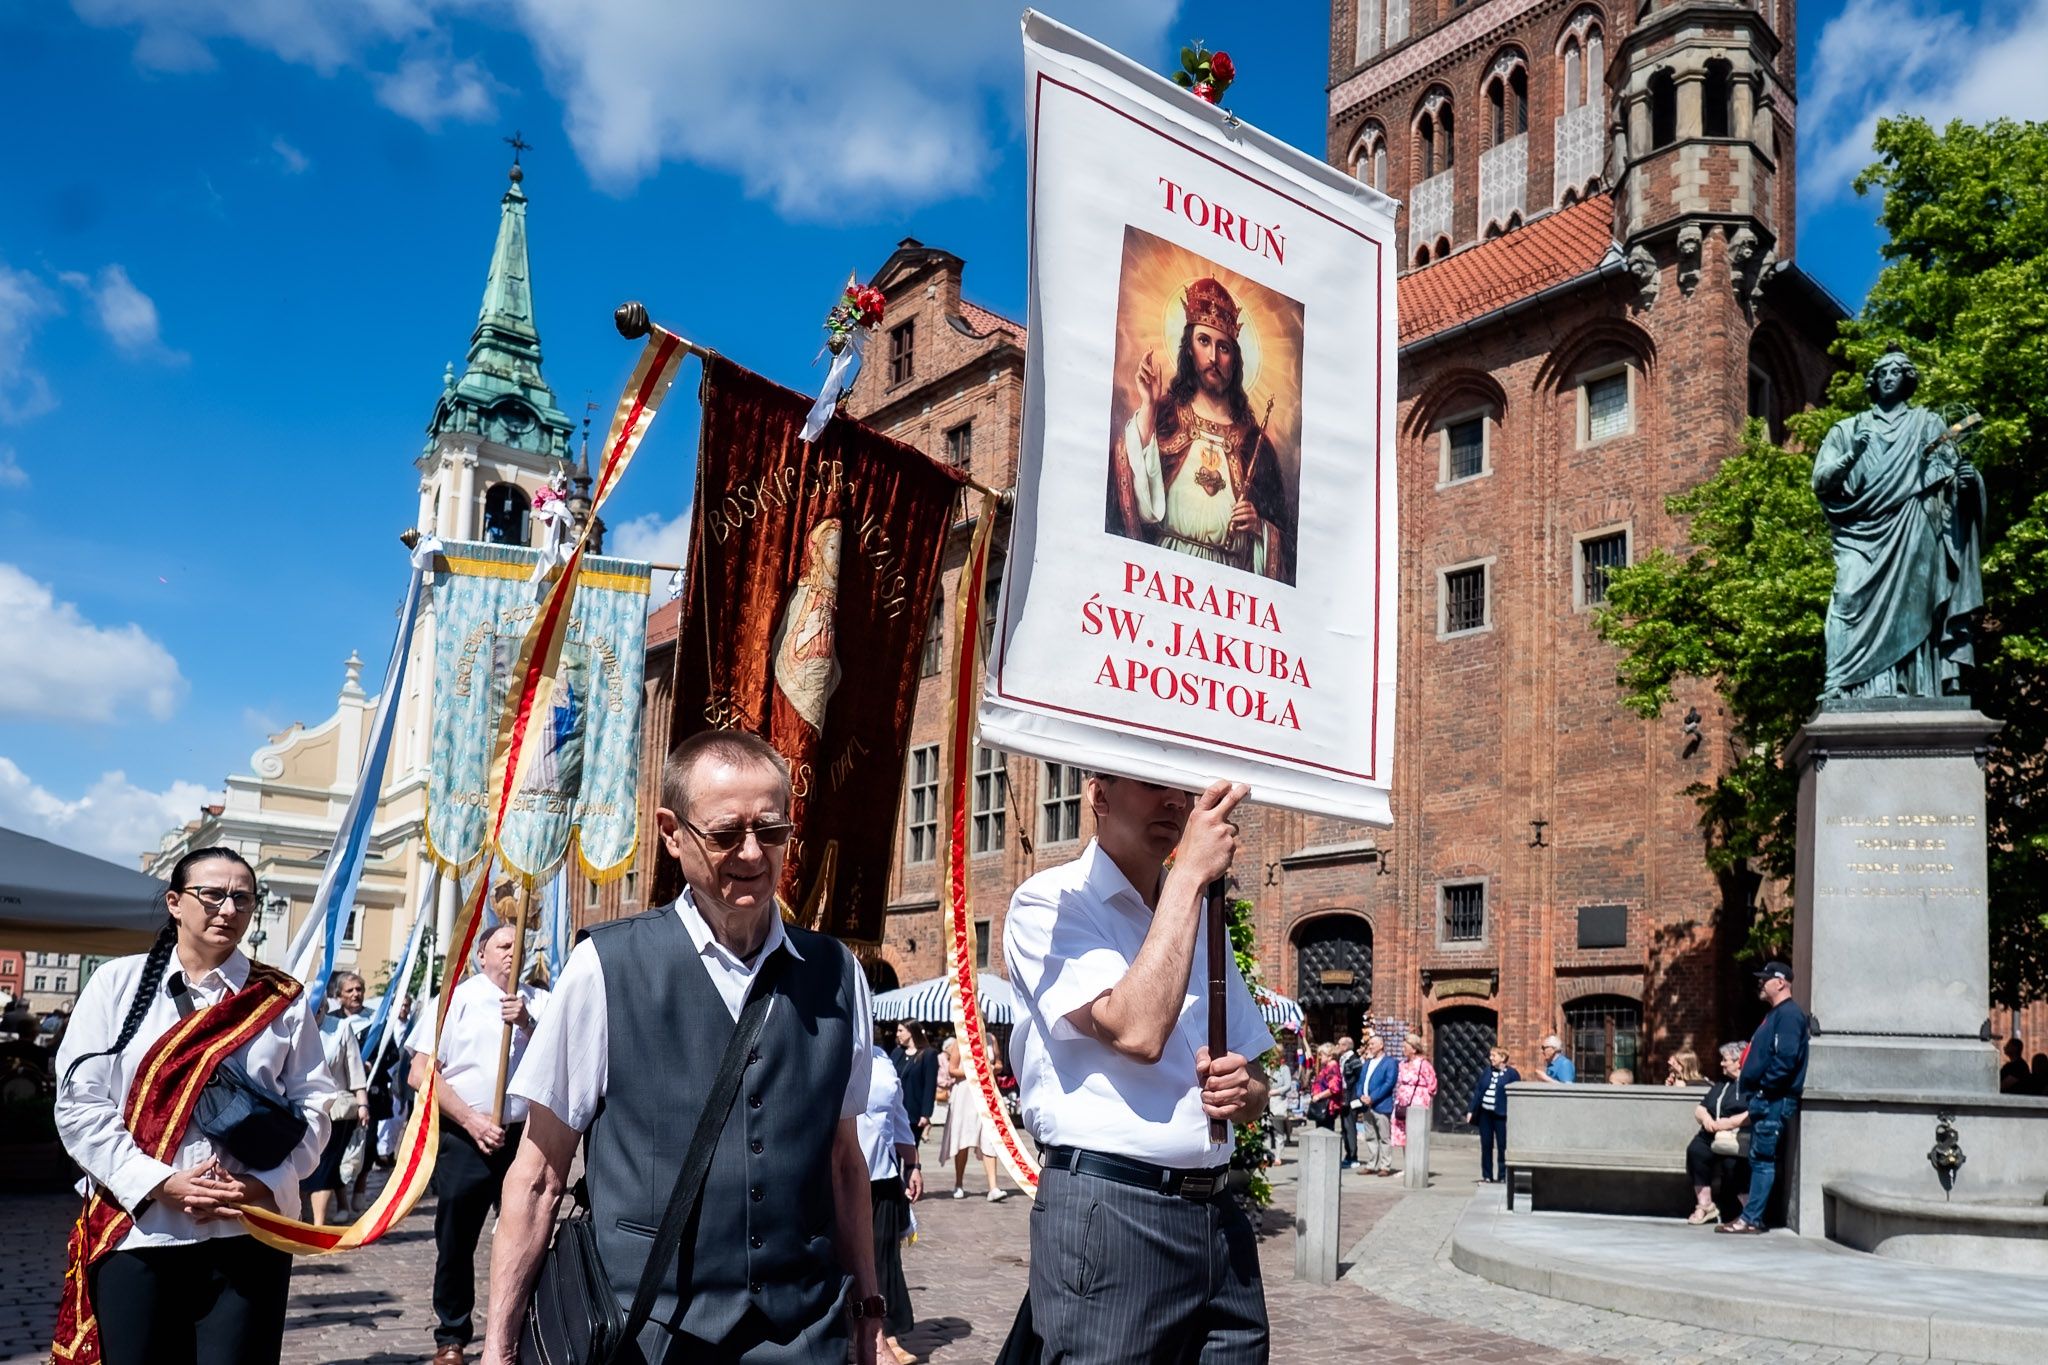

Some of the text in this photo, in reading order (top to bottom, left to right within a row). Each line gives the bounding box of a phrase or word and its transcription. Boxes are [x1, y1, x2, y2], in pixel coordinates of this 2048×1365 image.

[1159, 176, 1287, 266] TORUŃ
[708, 466, 799, 546] BOSKIE
[1123, 561, 1282, 633] PARAFIA
[1082, 593, 1312, 689] ŚW. JAKUBA
[1094, 654, 1302, 731] APOSTOŁA
